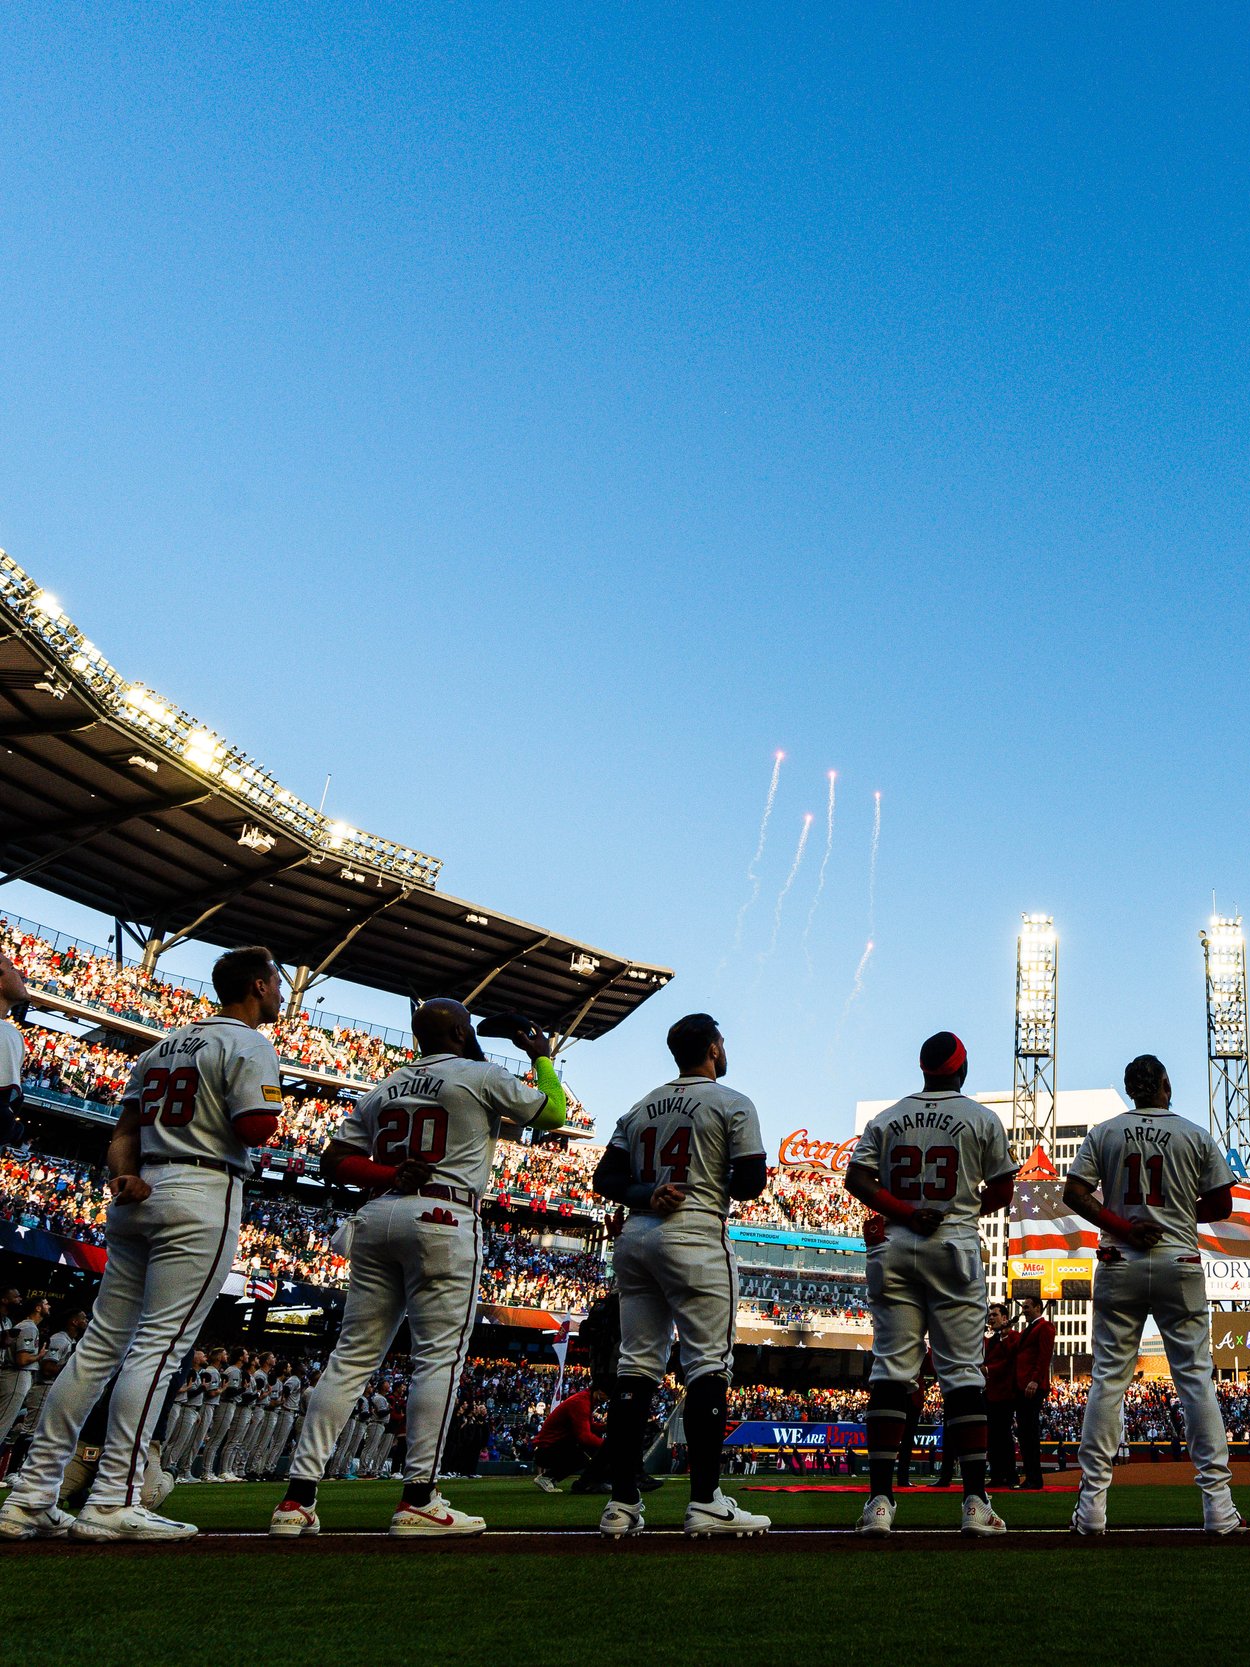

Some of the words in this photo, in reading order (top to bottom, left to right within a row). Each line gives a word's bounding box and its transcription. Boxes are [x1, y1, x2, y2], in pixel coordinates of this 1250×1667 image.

[159, 1037, 208, 1057] OLSON
[140, 1067, 200, 1127] 28
[388, 1078, 444, 1100] OZUNA
[647, 1096, 701, 1120] DUVALL
[377, 1106, 449, 1164] 20
[888, 1112, 954, 1137] HARRIS
[949, 1121, 967, 1138] II
[1123, 1126, 1172, 1148] ARCIA
[286, 1157, 305, 1174] 10
[639, 1126, 692, 1183] 14
[889, 1145, 960, 1201] 23
[1124, 1152, 1166, 1208] 11
[529, 1198, 547, 1213] 44
[1023, 1263, 1045, 1272] MEGA
[773, 1428, 804, 1444] WE
[803, 1434, 826, 1444] ARE
[876, 1507, 886, 1516] 23
[966, 1507, 977, 1516] 23
